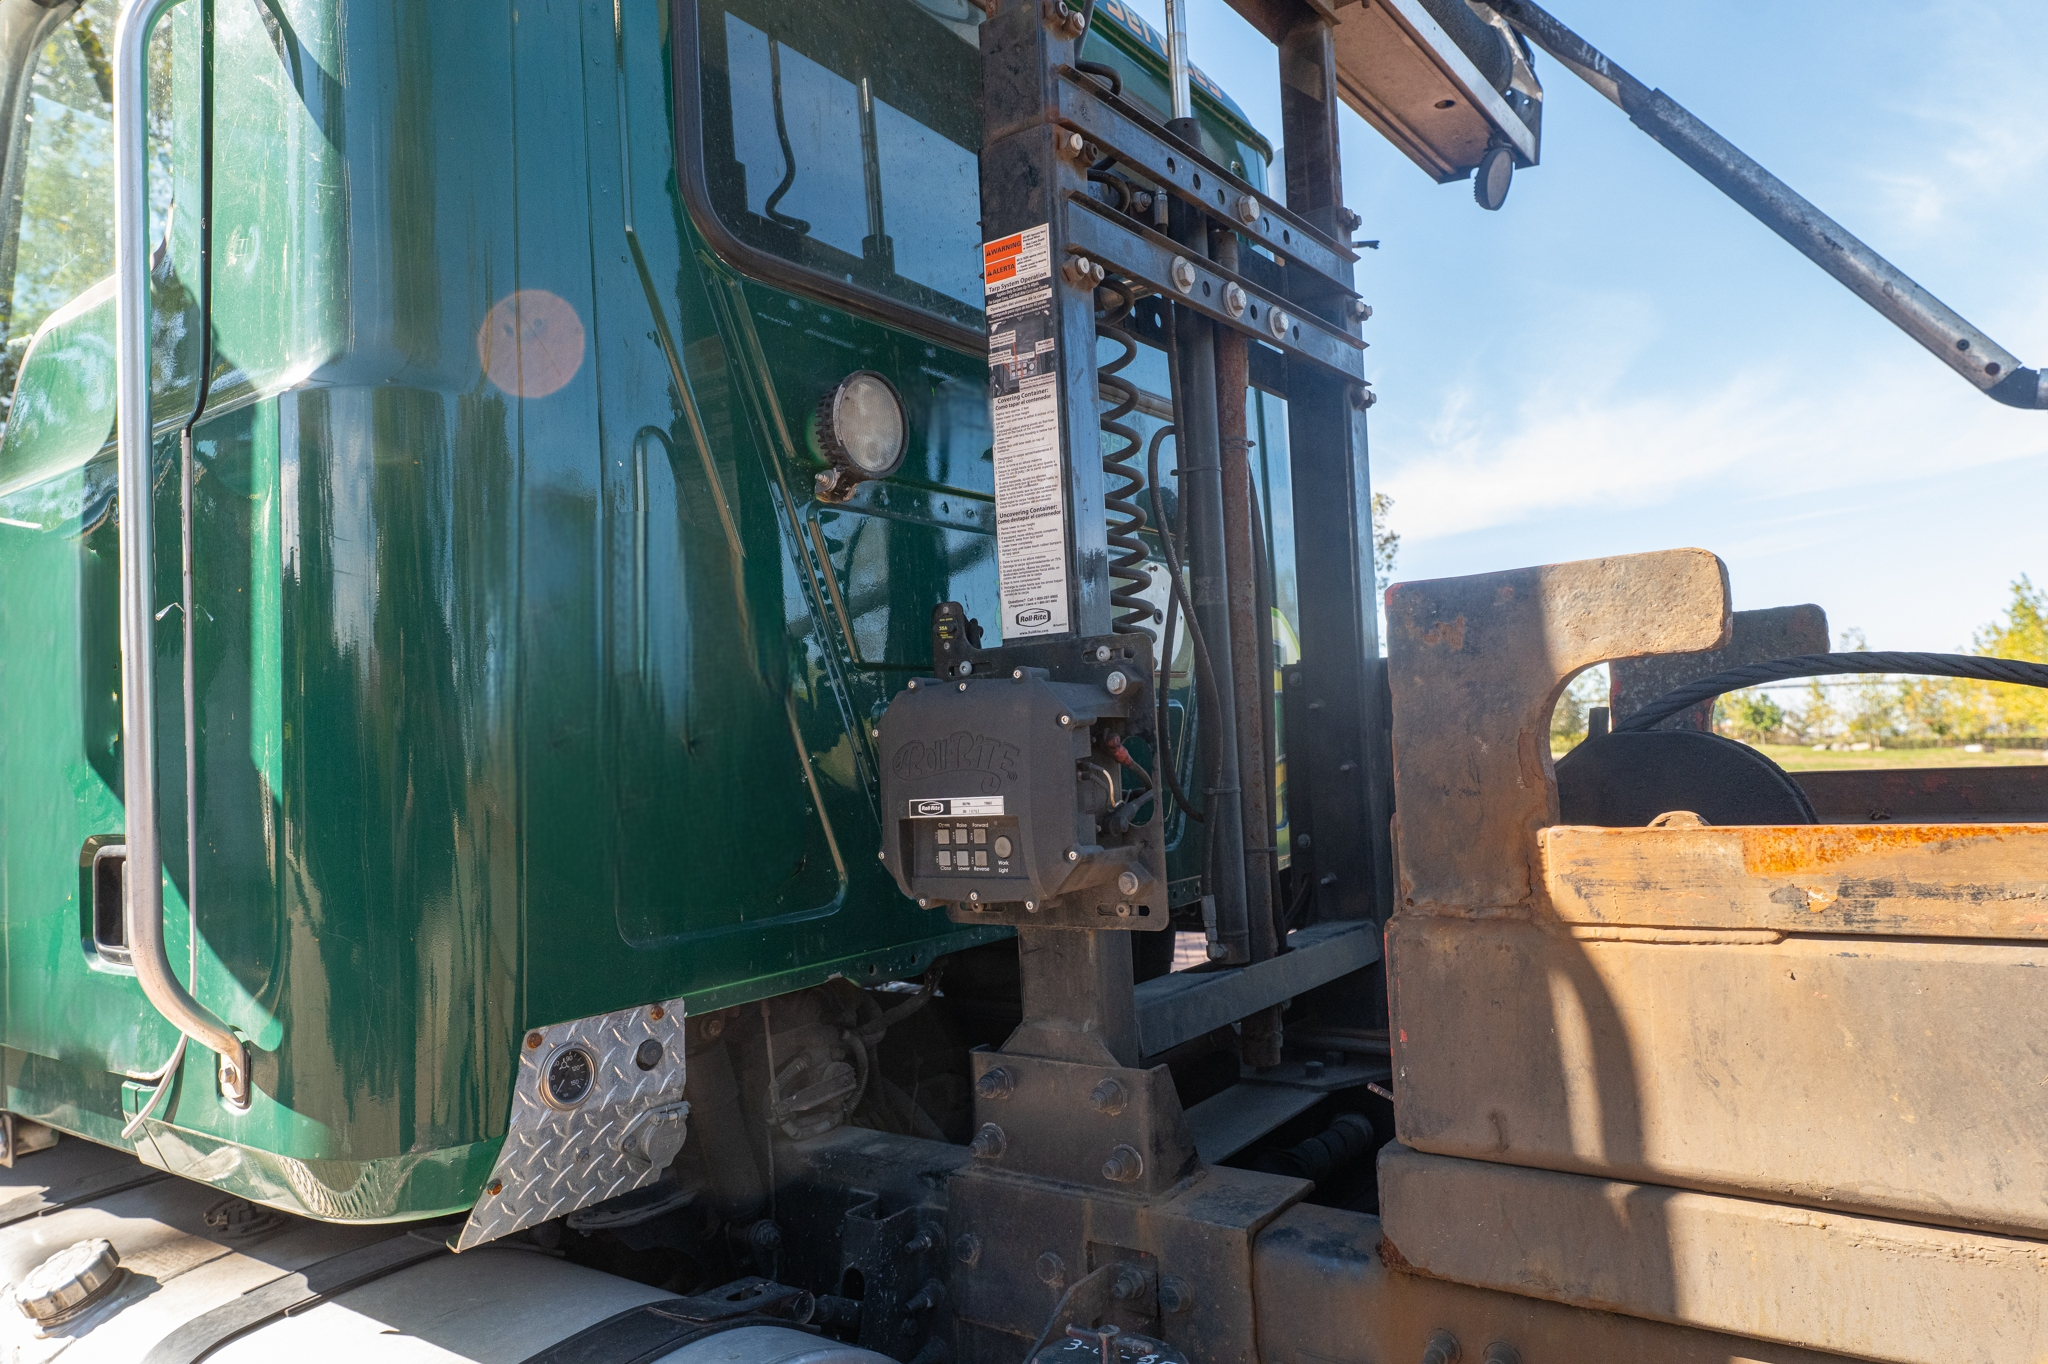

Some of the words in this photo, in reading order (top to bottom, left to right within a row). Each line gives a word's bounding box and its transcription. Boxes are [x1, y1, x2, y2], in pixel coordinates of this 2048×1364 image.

[991, 241, 1021, 255] WARNING
[993, 264, 1015, 275] ALERTA
[1001, 280, 1019, 289] System
[1020, 272, 1046, 283] Operation
[998, 395, 1020, 404] Covering
[1021, 388, 1049, 398] Container:
[1026, 394, 1051, 404] contenedor
[1000, 510, 1029, 519] Uncovering
[1030, 505, 1057, 514] Container:
[1036, 510, 1061, 518] contenedor
